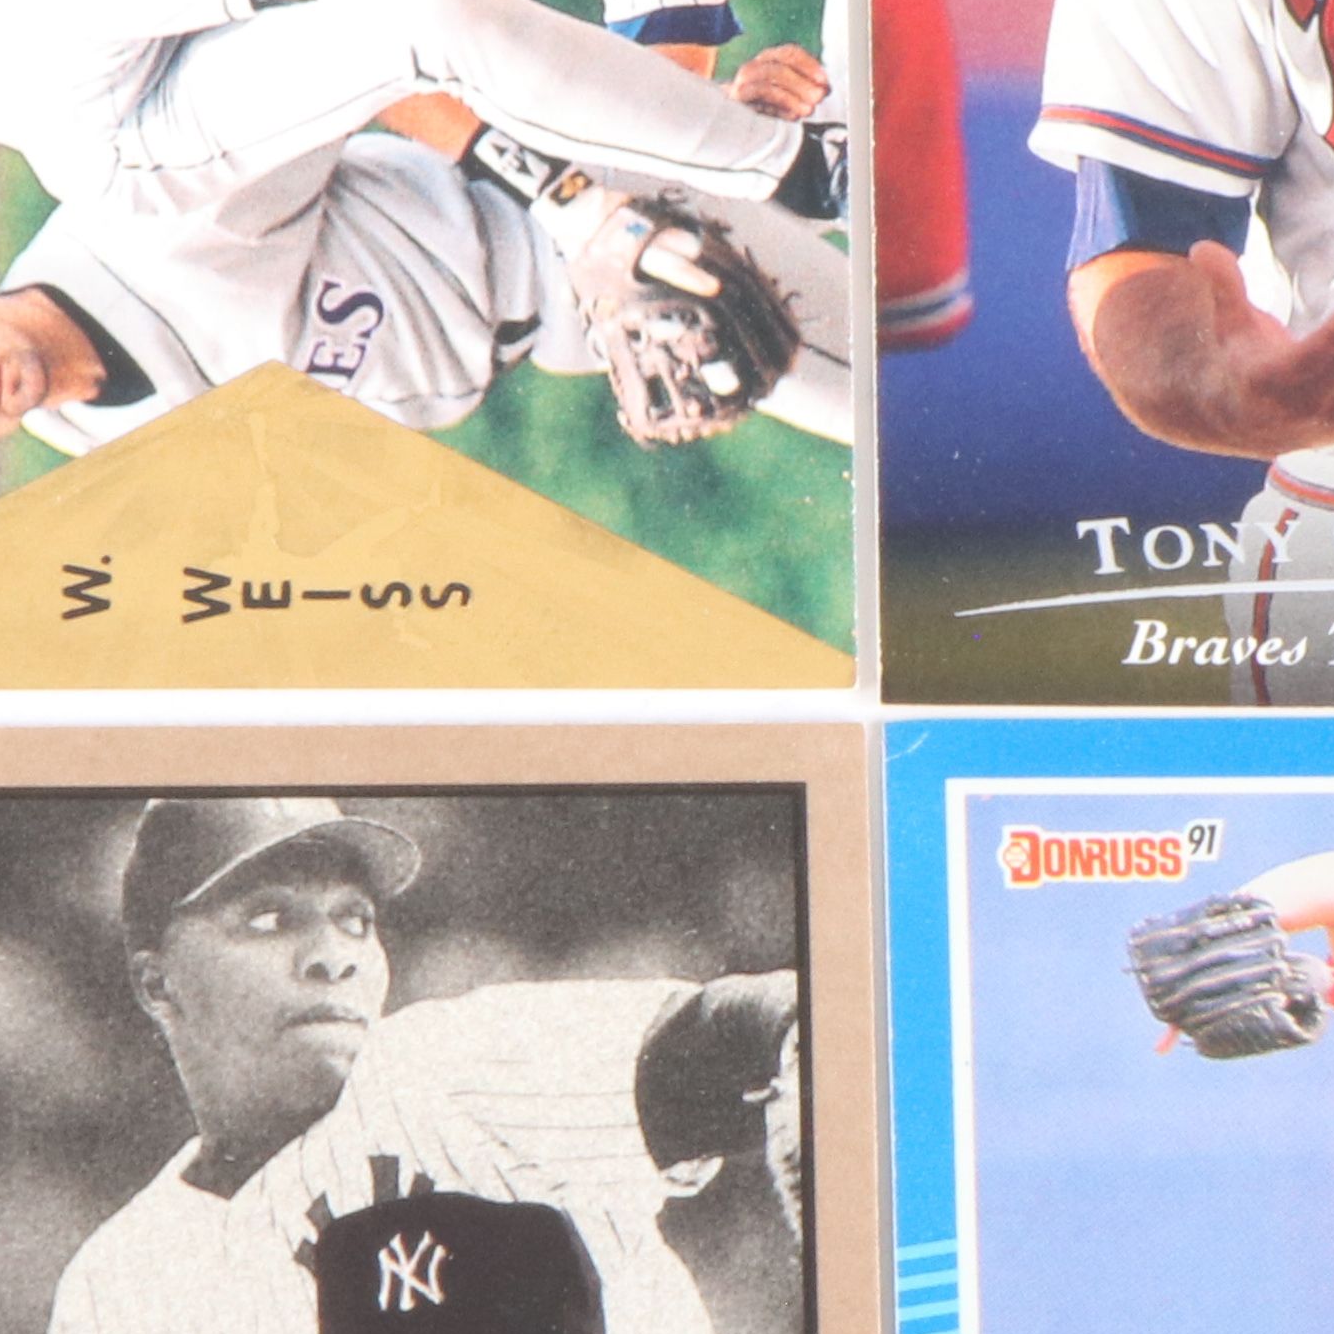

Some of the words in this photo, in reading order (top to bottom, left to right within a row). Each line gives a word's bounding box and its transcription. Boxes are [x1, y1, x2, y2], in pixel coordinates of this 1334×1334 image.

[61, 555, 112, 620] W.
[181, 566, 472, 624] WEISS
[1121, 619, 1308, 668] Braves
[1003, 831, 1183, 884] DONRUSS
[1188, 824, 1217, 856] 91
